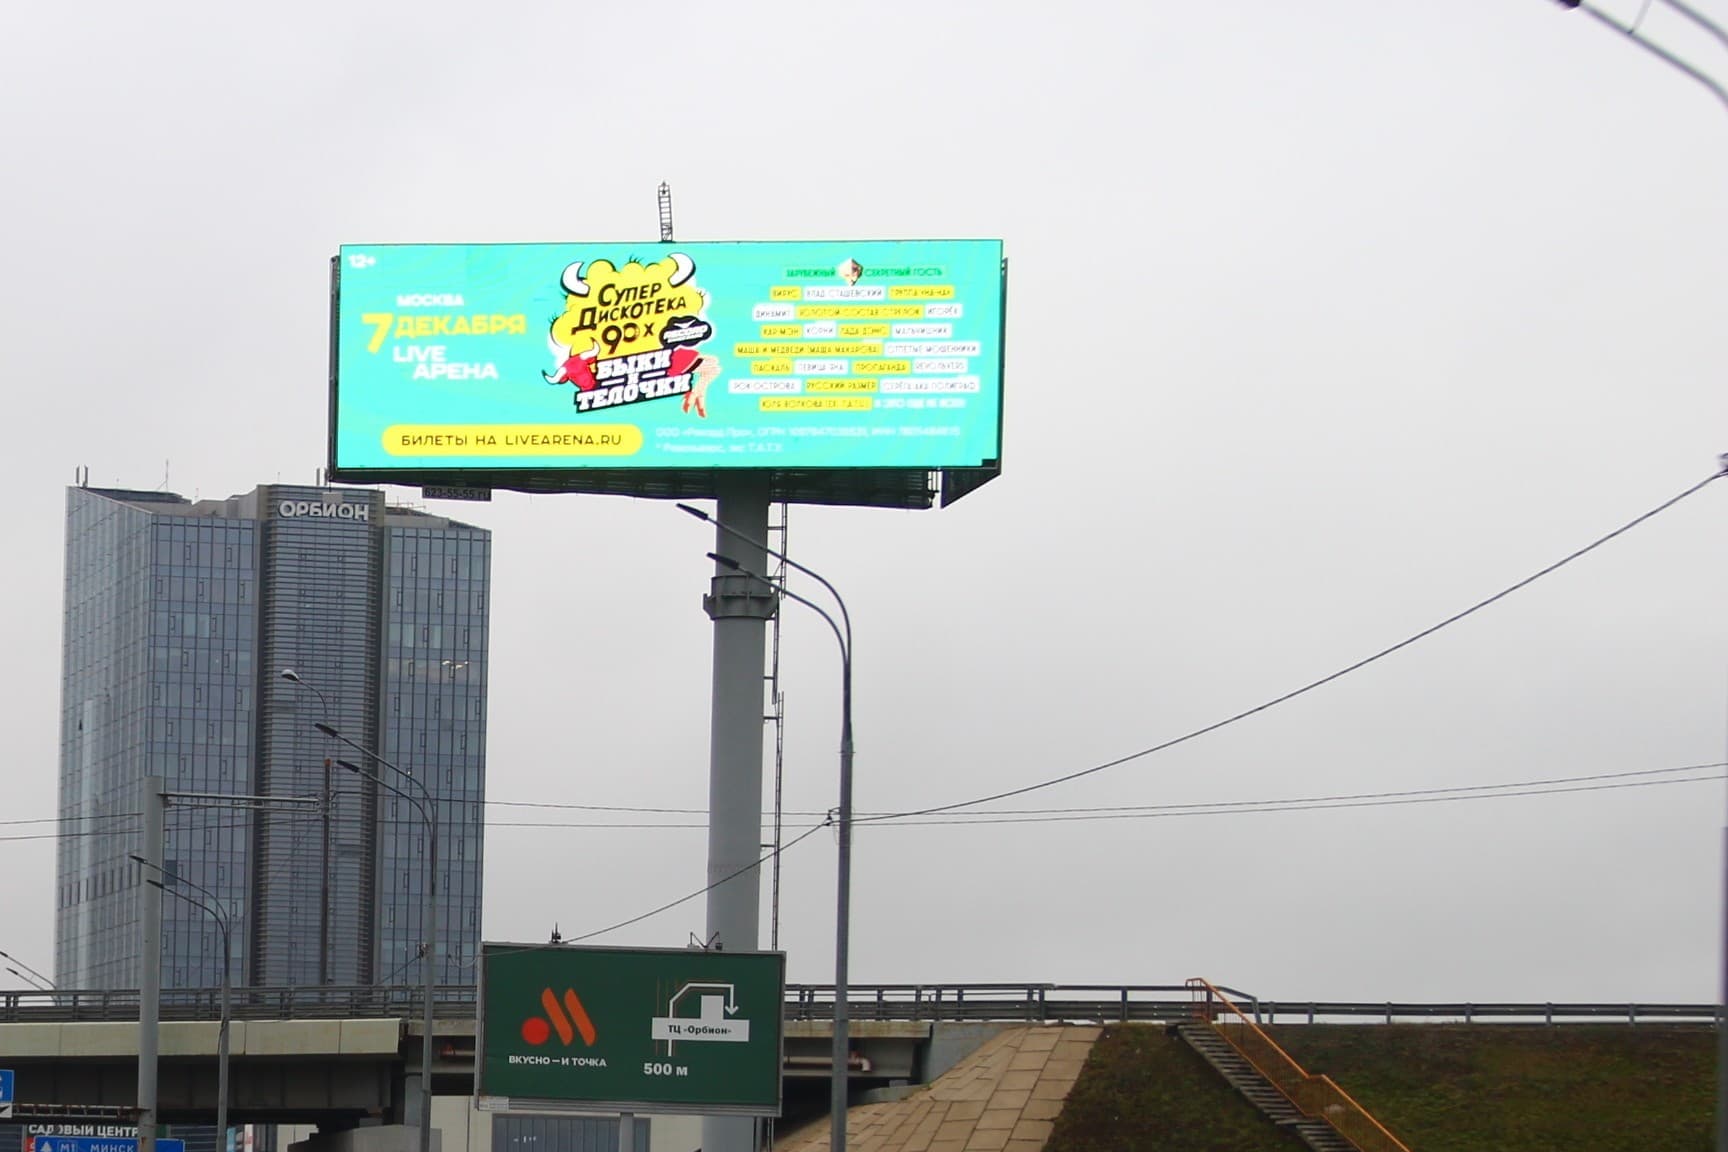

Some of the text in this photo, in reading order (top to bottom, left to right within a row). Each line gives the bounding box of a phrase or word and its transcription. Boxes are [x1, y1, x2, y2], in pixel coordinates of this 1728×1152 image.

[349, 255, 376, 269] 12+
[396, 294, 465, 307] МОСКВА
[362, 313, 526, 354] 7 ДЕКАБРЯ
[393, 346, 446, 362] LIVE
[412, 364, 499, 380] АРЕНА
[596, 350, 672, 380] БЫКИ
[576, 375, 691, 411] ТЕЛОЧКИ
[401, 434, 623, 446] БИЛЕТЫ НА LIVEARENA.RU
[279, 500, 369, 521] ОРБИОН
[668, 1025, 681, 1035] ТЦ
[508, 1055, 551, 1065] ВКУСНО
[561, 1057, 569, 1066] И
[571, 1057, 607, 1067] ТОЧКА
[643, 1062, 672, 1075] 500
